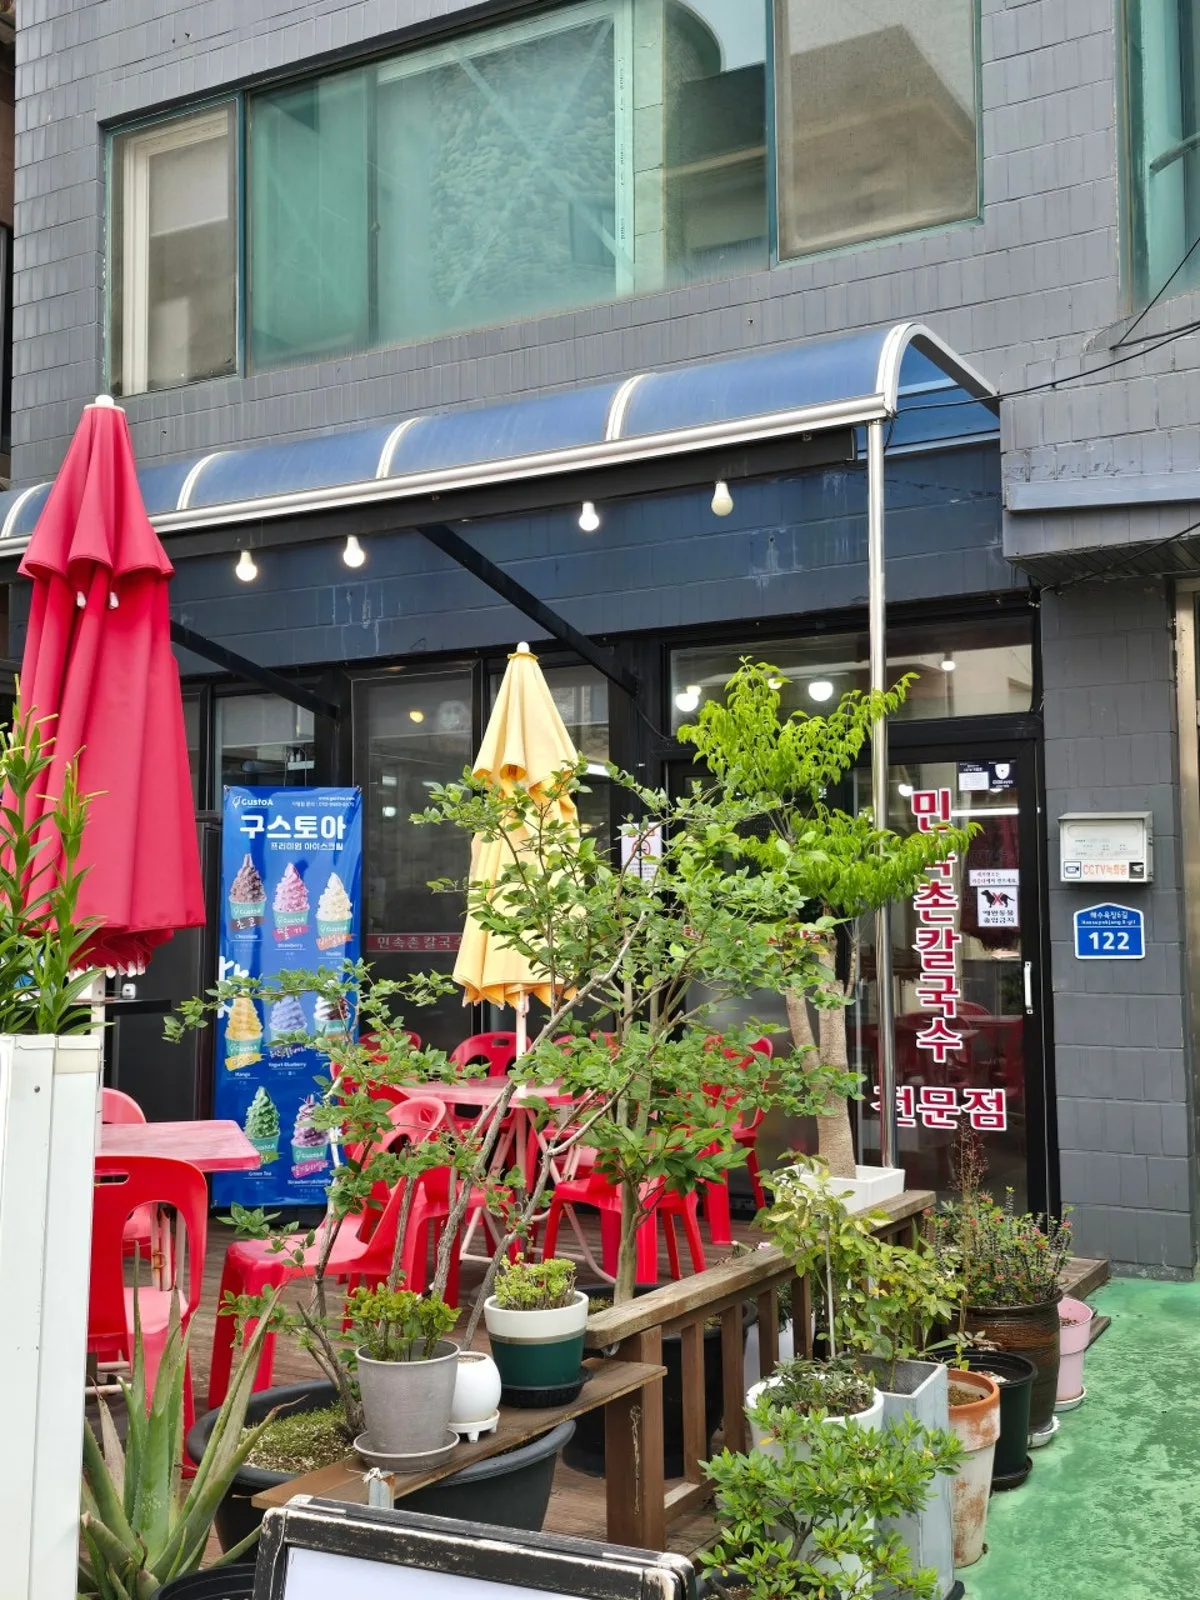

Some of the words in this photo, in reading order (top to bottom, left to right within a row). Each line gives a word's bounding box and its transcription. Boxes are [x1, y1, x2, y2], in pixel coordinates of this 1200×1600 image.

[240, 815, 347, 839] 구스토아
[271, 842, 302, 851] 프리미엄
[304, 842, 344, 851] 아이스크림
[1089, 932, 1130, 950] 122
